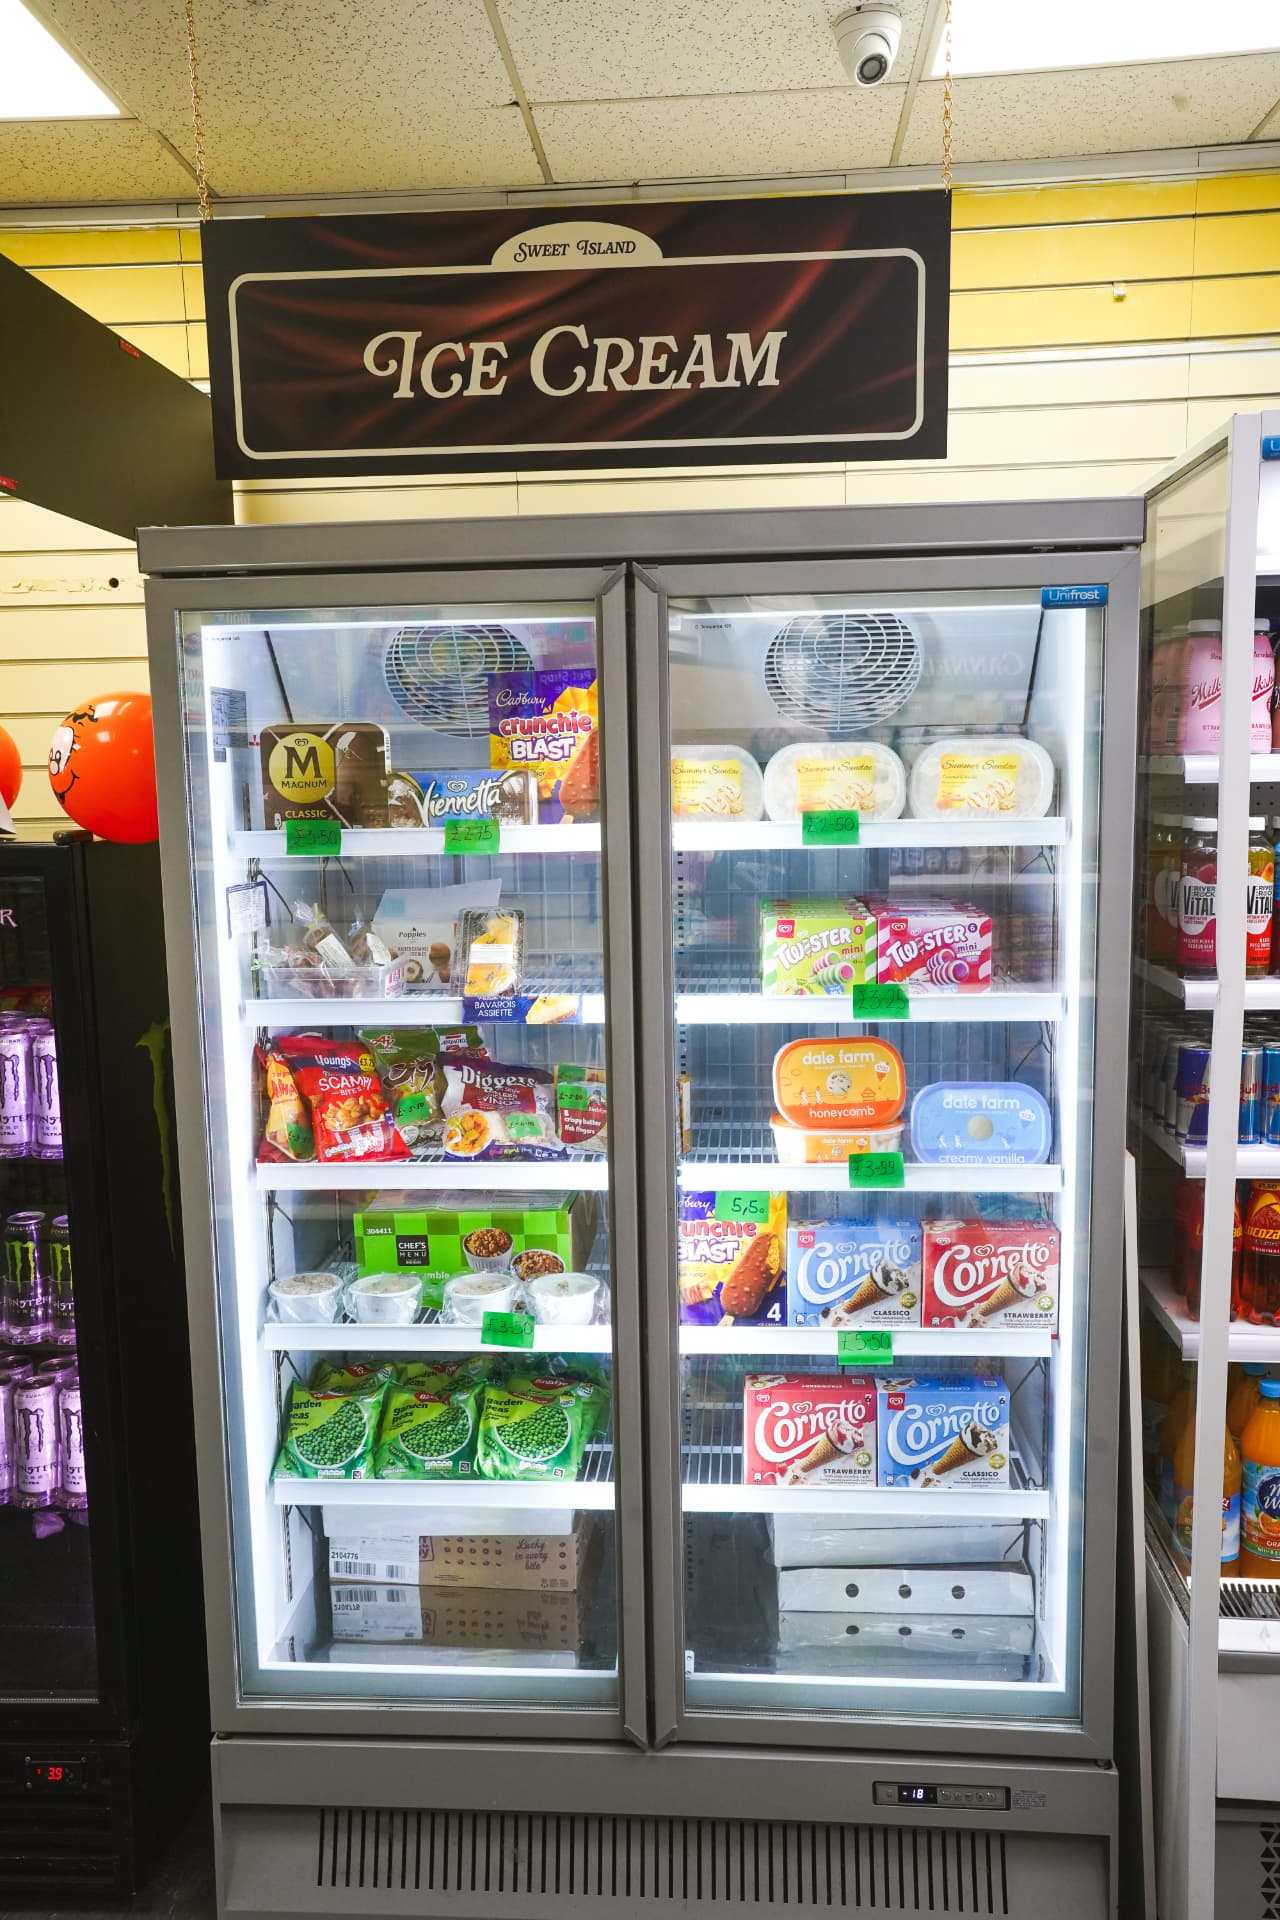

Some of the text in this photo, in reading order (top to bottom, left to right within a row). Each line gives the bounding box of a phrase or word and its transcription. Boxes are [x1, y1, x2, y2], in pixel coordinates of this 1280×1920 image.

[513, 240, 636, 263] SWEET ISLAND
[363, 324, 788, 399] ICE CREAM
[1049, 589, 1100, 601] Unifrost
[496, 689, 546, 708] Cadbury
[499, 710, 592, 736] crunchie
[511, 736, 576, 761] BLAST
[281, 779, 327, 789] MAGNUM
[409, 778, 503, 828] Viennetta
[284, 809, 327, 819] CLASSIC
[477, 1008, 512, 1017] ASSIETTE
[803, 1049, 875, 1065] dale farm
[943, 1093, 977, 1109] dale
[808, 1105, 876, 1119] honeycomb
[938, 1151, 1025, 1164] creamy vanilla
[398, 1241, 427, 1250] CHEF'S
[796, 1240, 913, 1305] Cornetto
[933, 1242, 1051, 1308] Cornetto
[766, 1302, 782, 1322] 4
[755, 1400, 867, 1463] Cornetto
[887, 1402, 1001, 1466] Cornetto
